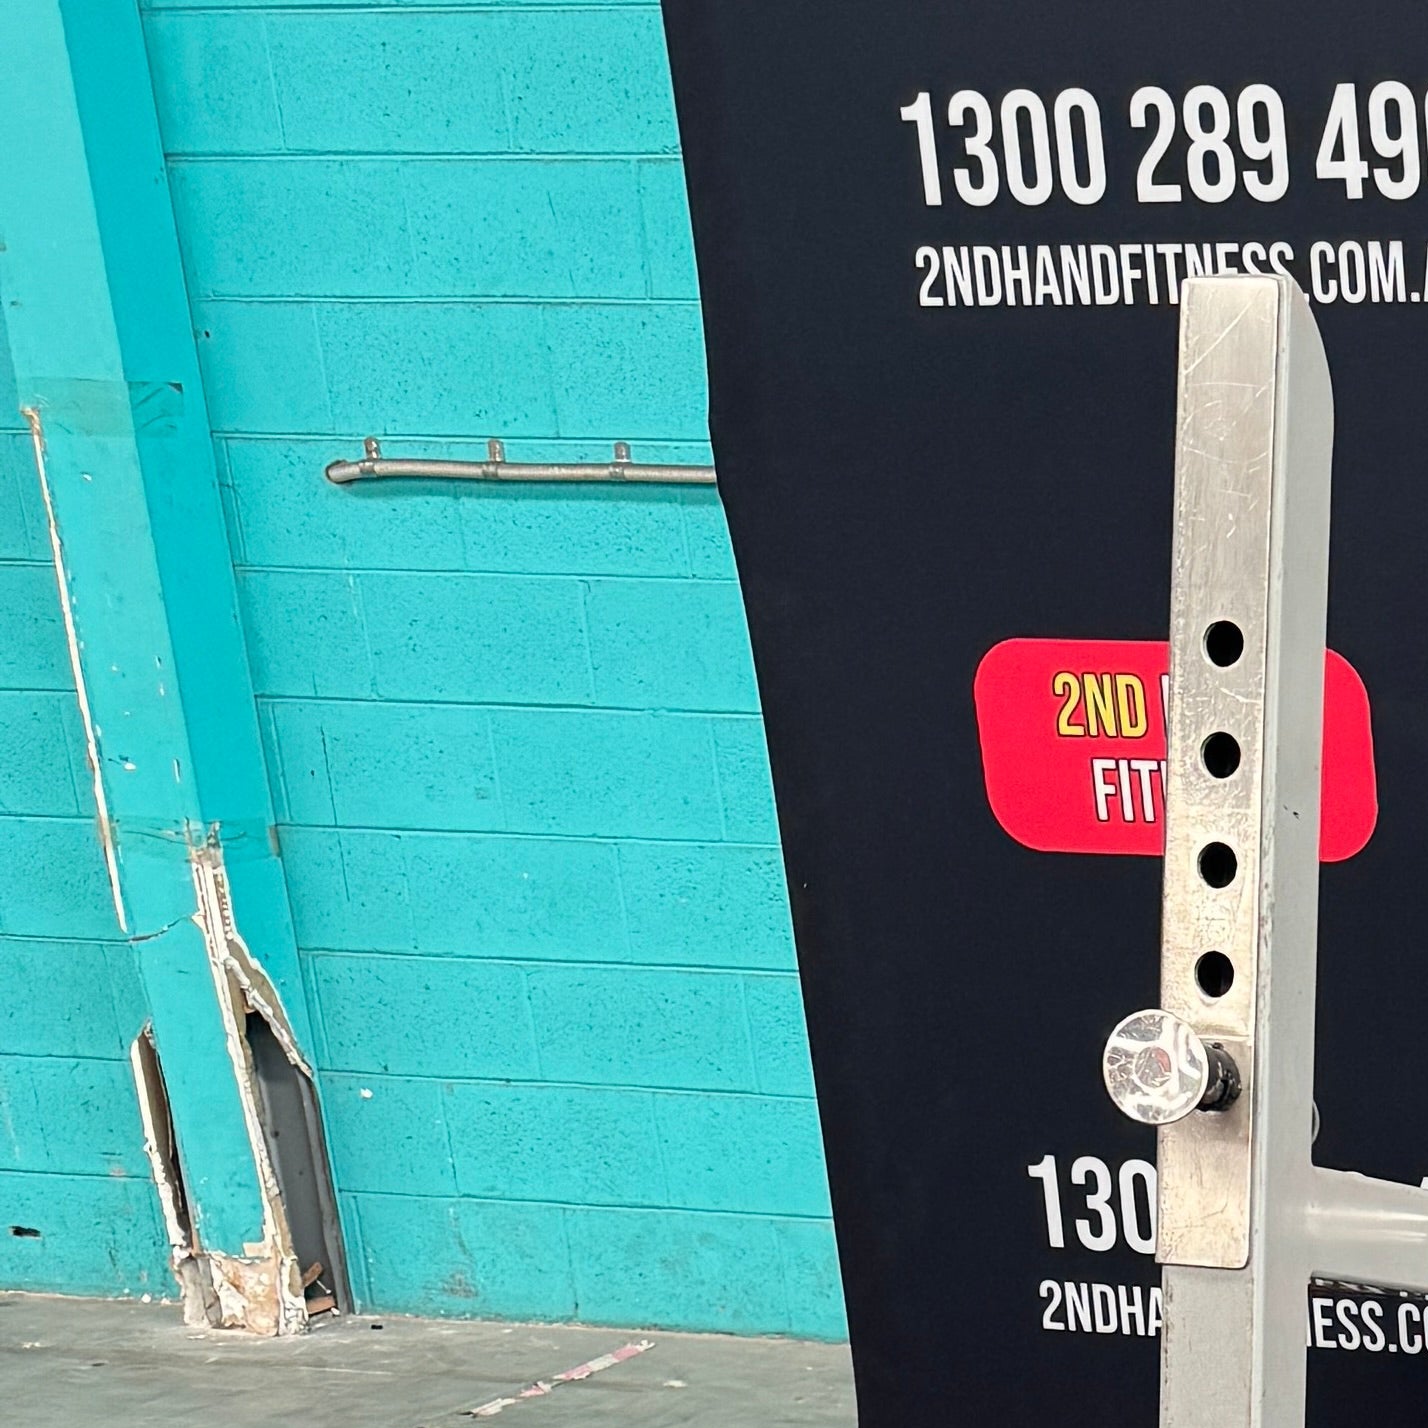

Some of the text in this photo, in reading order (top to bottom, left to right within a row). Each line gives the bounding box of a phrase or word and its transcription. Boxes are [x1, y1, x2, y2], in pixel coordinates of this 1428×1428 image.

[898, 86, 1108, 208] 1300
[1128, 82, 1291, 204] 289
[1053, 671, 1148, 738] 2ND
[1028, 1154, 1157, 1254] 130
